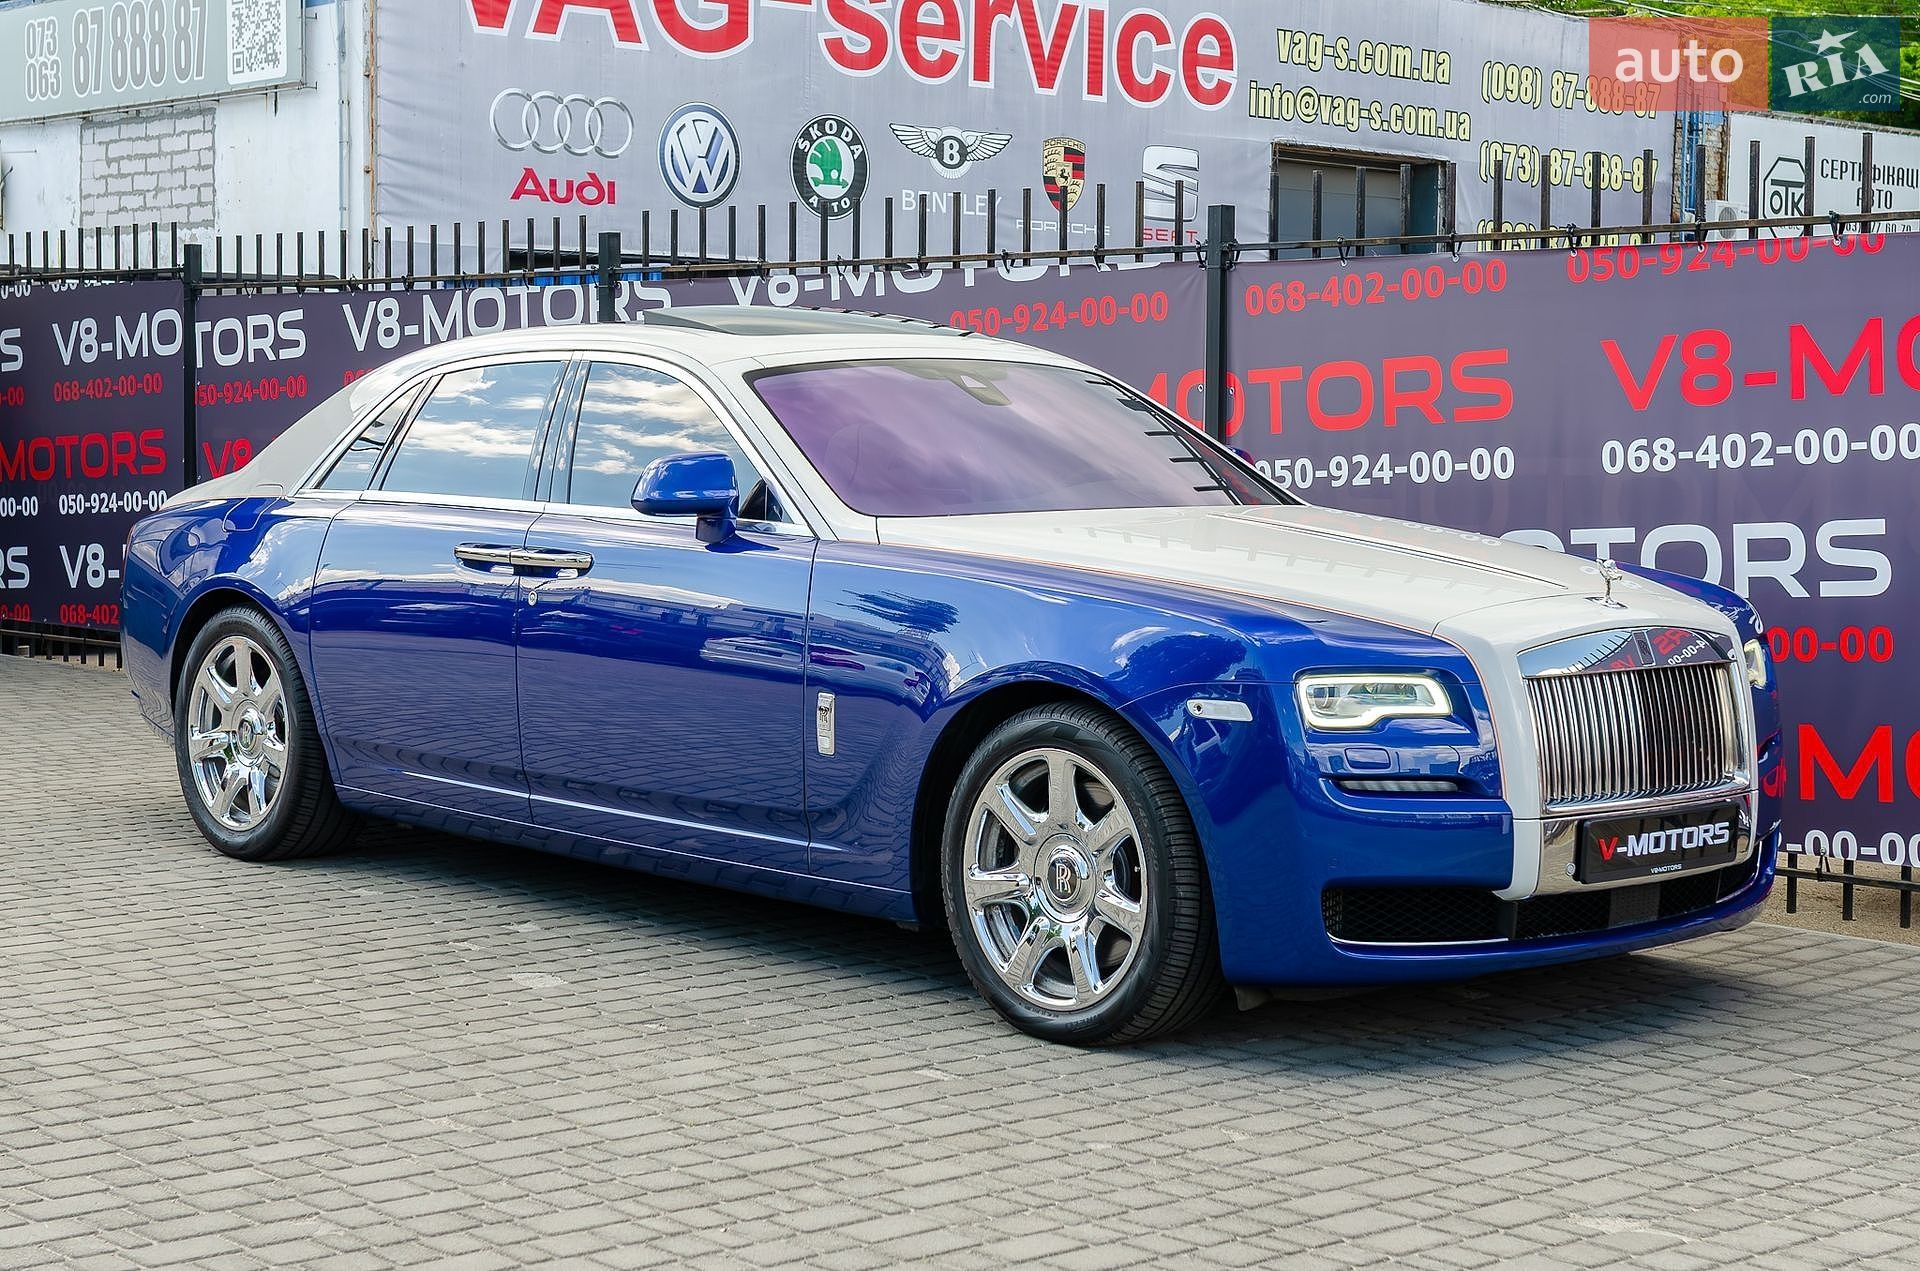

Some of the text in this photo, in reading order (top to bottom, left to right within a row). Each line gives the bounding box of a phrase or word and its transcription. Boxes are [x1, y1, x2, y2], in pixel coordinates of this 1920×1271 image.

[25, 17, 58, 61] 073
[72, 0, 208, 97] 87 888 87
[465, 0, 1238, 111] -service
[1276, 28, 1451, 85] vag-s.com.ua
[25, 57, 62, 102] 063
[1481, 60, 1661, 119] (098) 87-888-87
[1249, 80, 1471, 141] info@vag-s.com.ua
[797, 119, 864, 160] SKODA
[1044, 139, 1084, 150] PORSCHE
[510, 167, 617, 205] Audi
[1478, 140, 1540, 188] (073)
[808, 195, 851, 213] ATO
[902, 189, 1002, 216] BNLE
[1016, 219, 1110, 236] PORCH
[1566, 233, 1887, 283] 050-924-00-00
[1245, 259, 1507, 316] 068-402-00-00
[949, 291, 1169, 337] 050-924-00-00
[53, 372, 163, 402] 068-402-00-00
[194, 374, 307, 407] 50-924-00-00
[1601, 423, 1920, 475] 068-402-00-00
[59, 489, 167, 515] 050-924-00-00
[0, 543, 127, 589] S V8-
[1798, 722, 1920, 803] M
[1598, 821, 1730, 861] V-MOTORS
